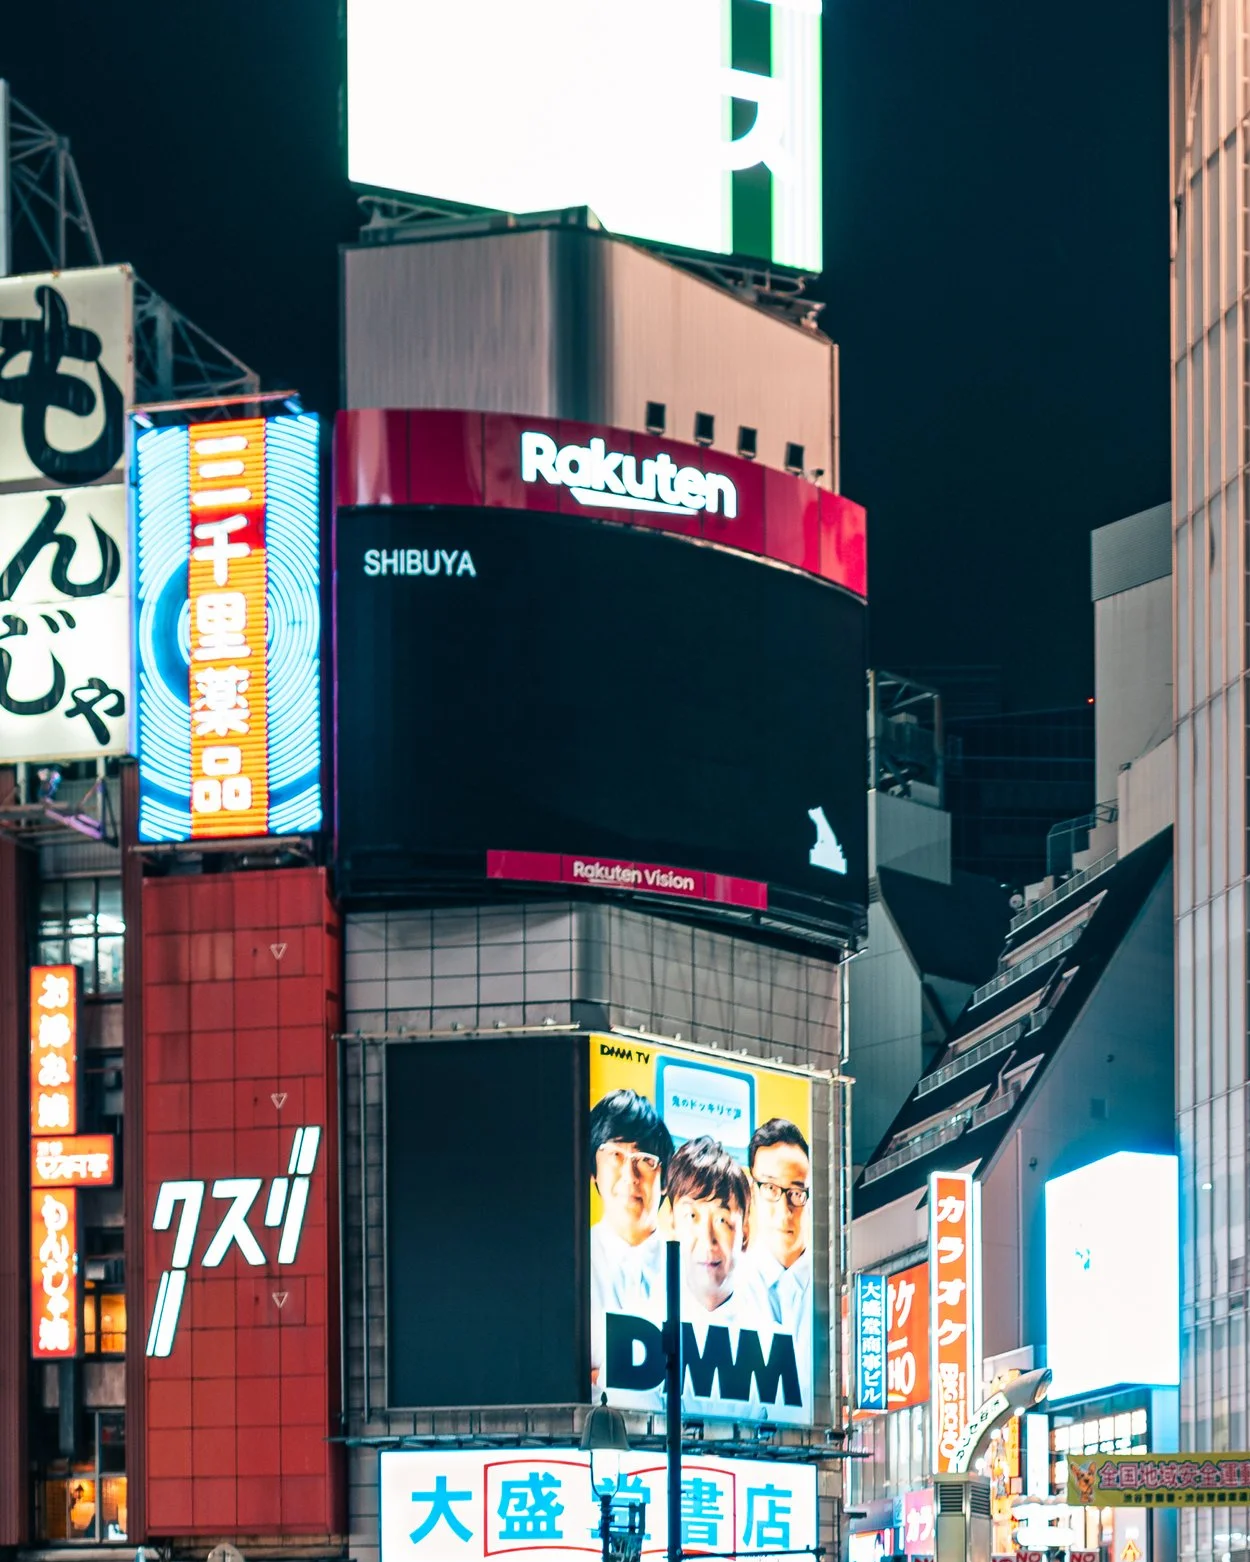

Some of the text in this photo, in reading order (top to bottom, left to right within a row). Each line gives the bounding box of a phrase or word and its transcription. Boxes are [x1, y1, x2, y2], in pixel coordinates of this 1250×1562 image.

[521, 430, 737, 519] Rakuten
[363, 549, 477, 578] SHIBUYA
[190, 434, 252, 813] 三千里薬品
[573, 860, 694, 890] Rakuten Vision
[600, 1044, 650, 1064] DMM TV
[145, 1126, 322, 1358] クスリ
[936, 1196, 965, 1346] カラオケ
[605, 1313, 802, 1408] DMM
[410, 1472, 793, 1549] 大盛堂書店
